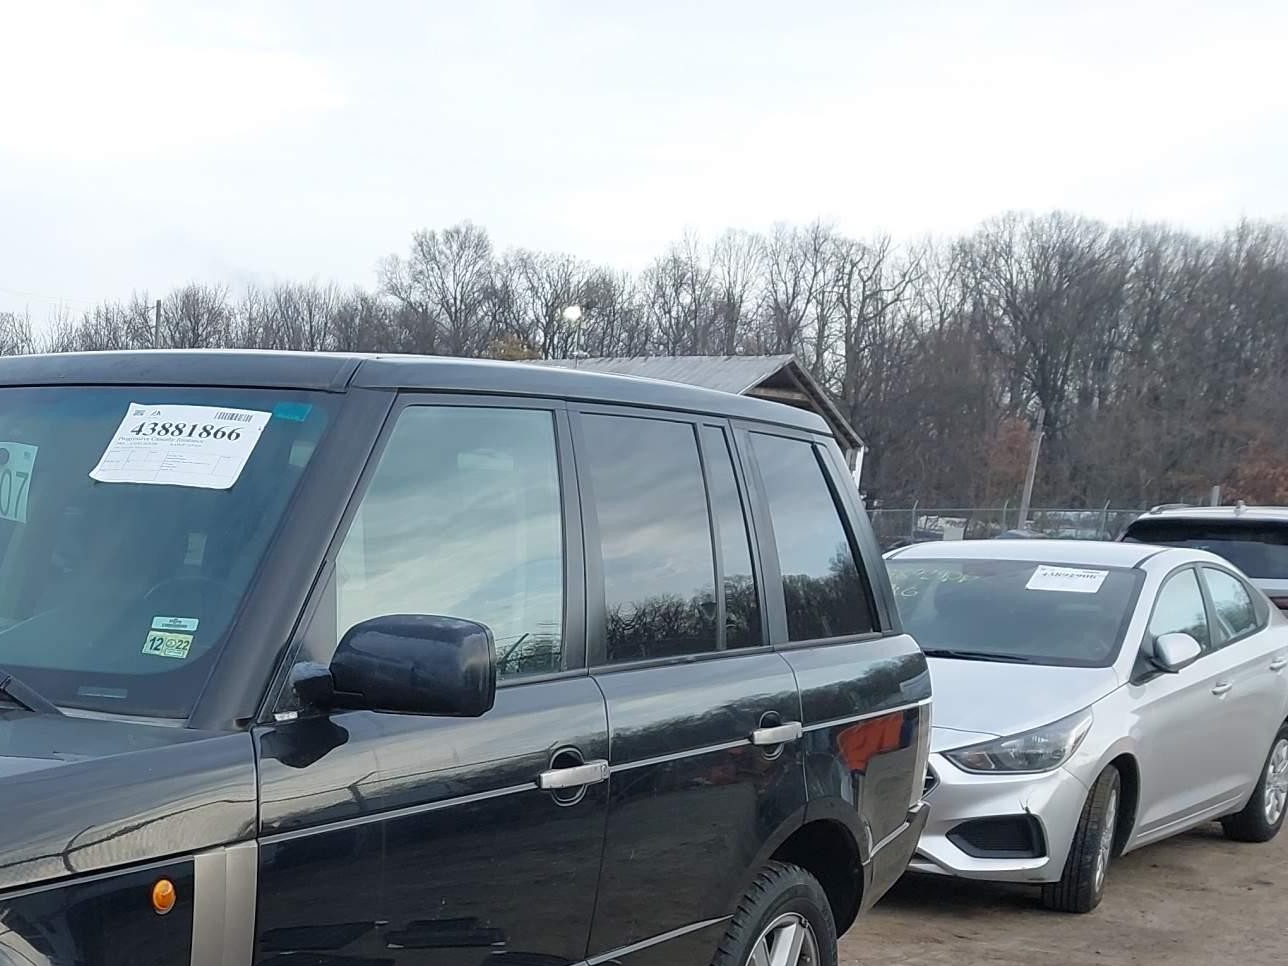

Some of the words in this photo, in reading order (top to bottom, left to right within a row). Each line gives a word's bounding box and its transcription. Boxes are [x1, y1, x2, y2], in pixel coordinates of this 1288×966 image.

[130, 421, 242, 442] 43881866
[149, 636, 164, 651] 12
[175, 639, 190, 651] 22
